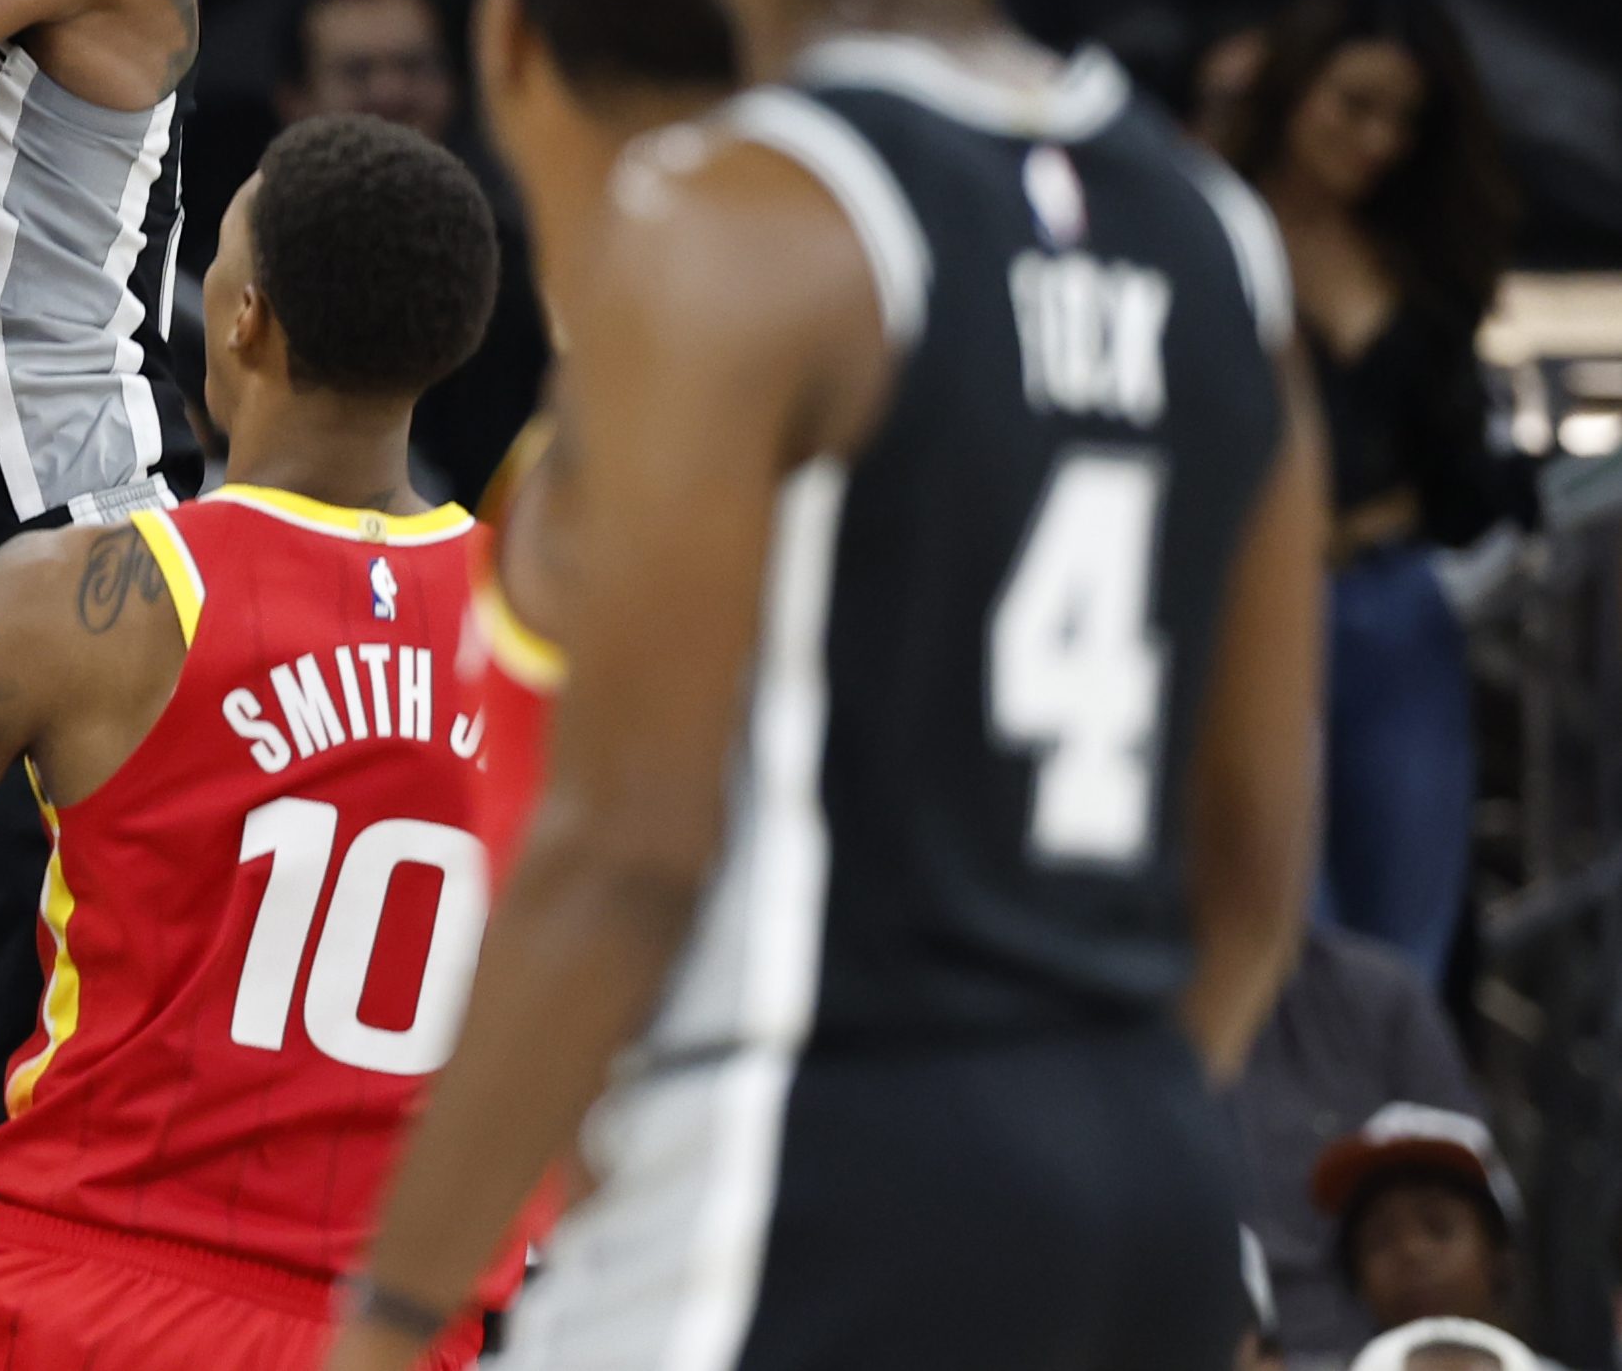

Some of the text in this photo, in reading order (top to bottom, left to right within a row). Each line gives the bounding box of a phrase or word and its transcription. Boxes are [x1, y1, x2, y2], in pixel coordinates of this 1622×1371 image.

[222, 643, 432, 775] SMITH
[986, 447, 1168, 867] 4
[230, 795, 490, 1077] 10
